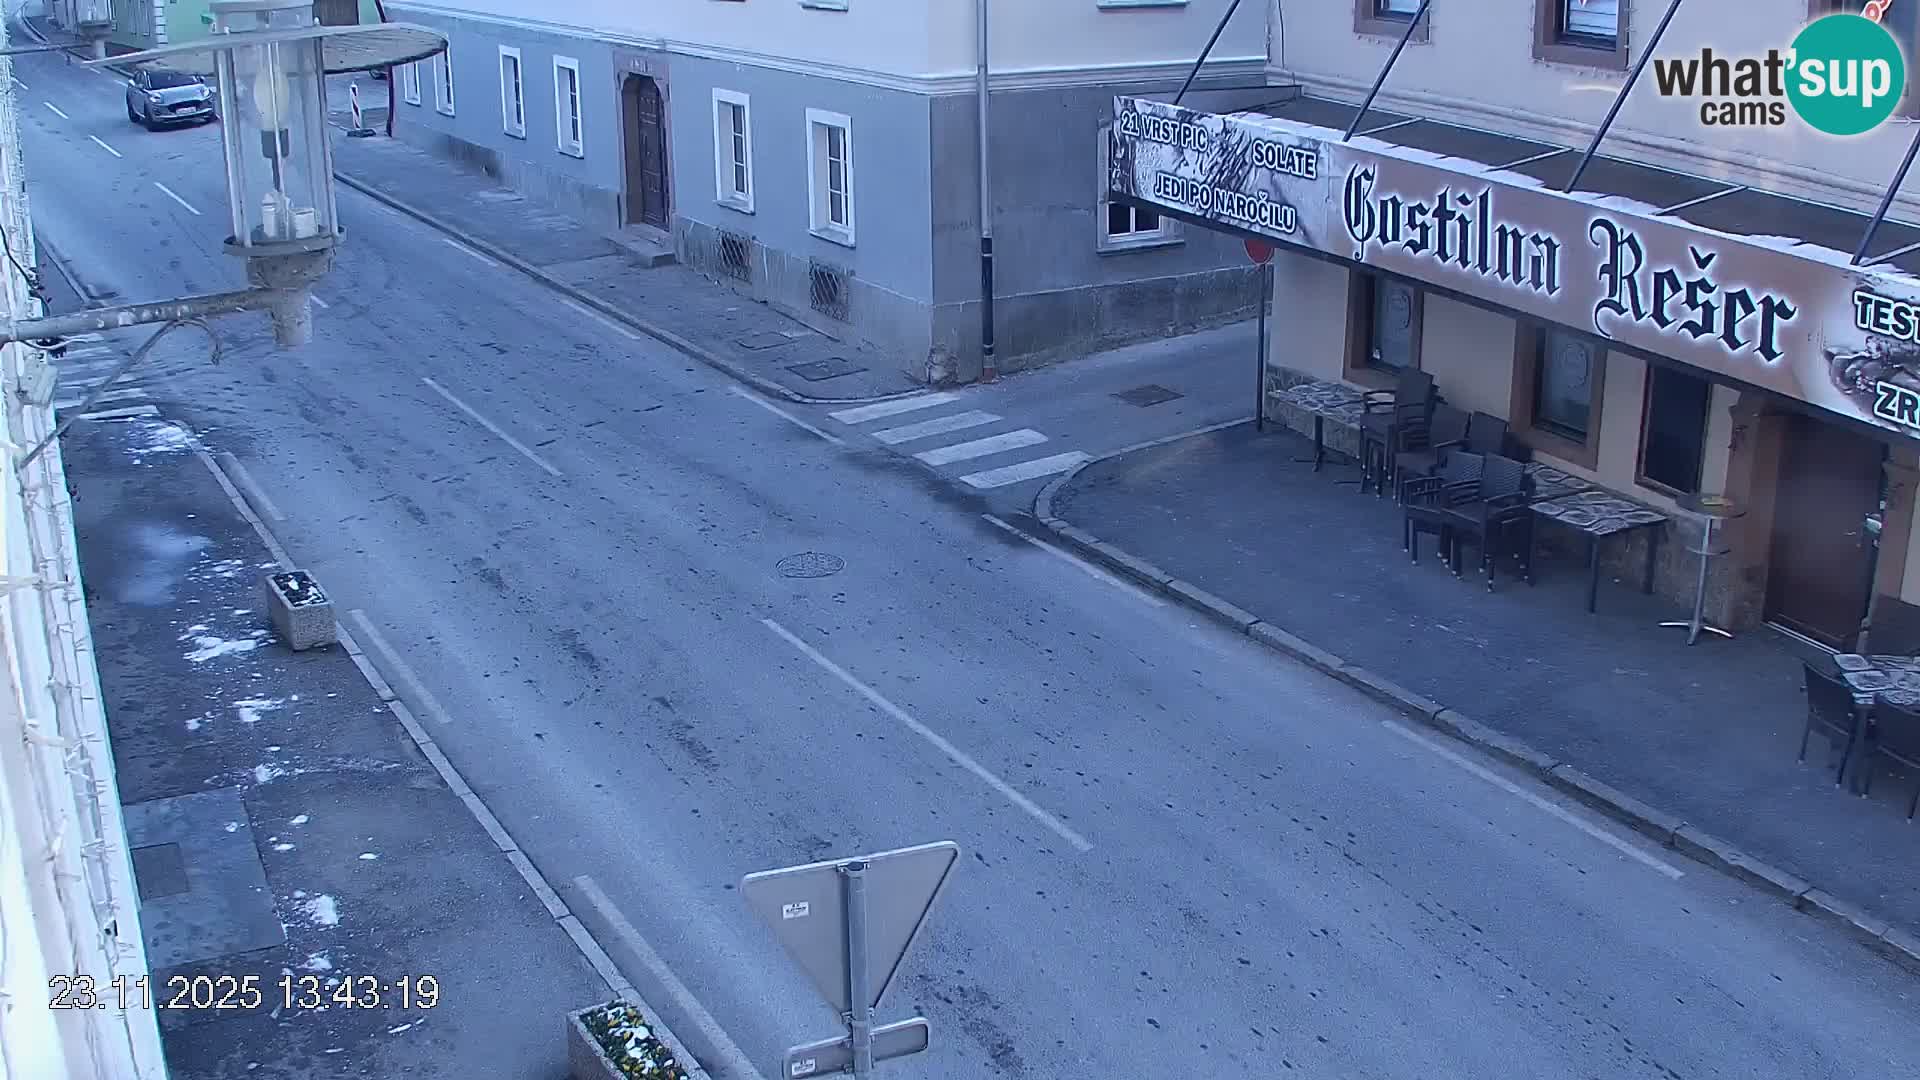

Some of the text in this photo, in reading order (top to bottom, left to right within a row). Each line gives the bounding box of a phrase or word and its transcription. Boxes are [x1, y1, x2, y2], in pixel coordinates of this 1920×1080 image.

[1122, 111, 1209, 151] 21 VRST PIC
[1253, 140, 1317, 179] SOLATE
[1155, 172, 1296, 233] JEDI PO NAROČILU
[1343, 163, 1798, 362] Gostilna Rešer
[1875, 382, 1920, 429] ZR
